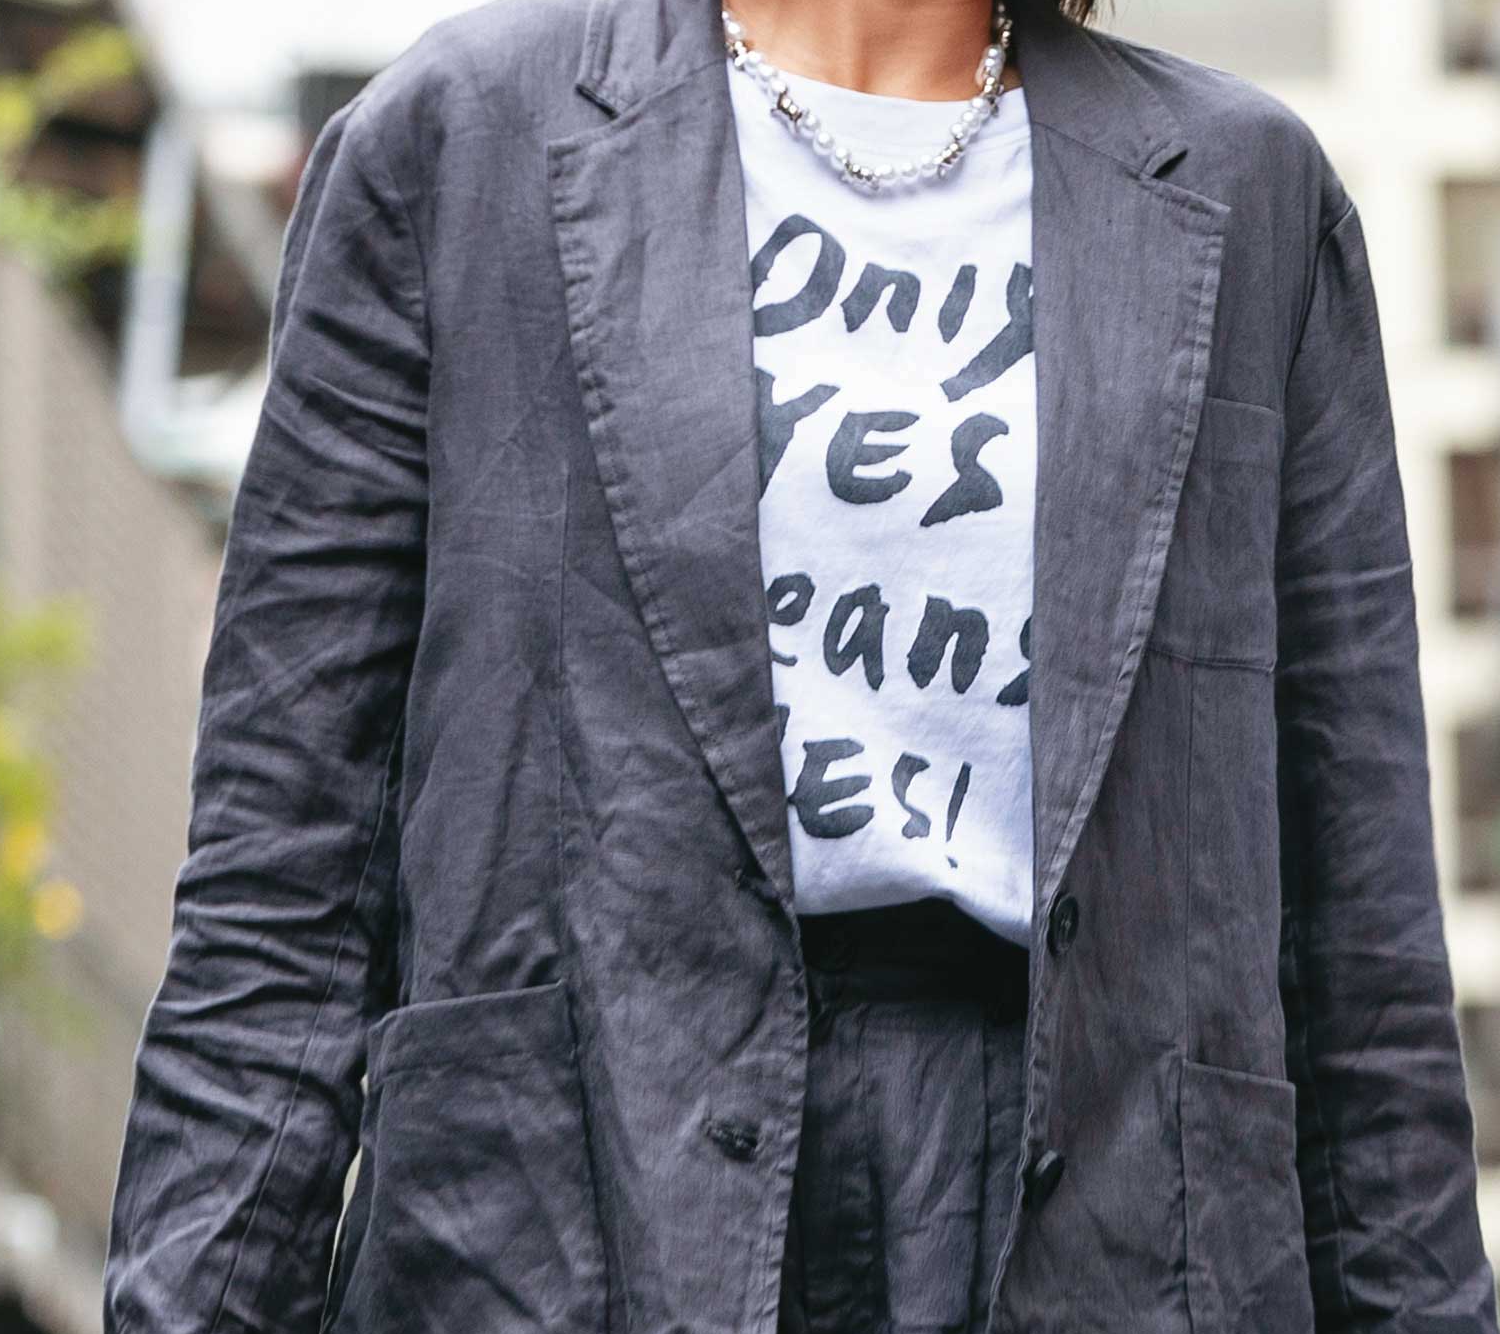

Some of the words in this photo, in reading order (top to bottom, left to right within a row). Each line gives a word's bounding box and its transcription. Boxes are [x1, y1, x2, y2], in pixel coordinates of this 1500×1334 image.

[750, 213, 1035, 403] Only
[754, 366, 1009, 527] YES
[775, 703, 973, 869] ES!
